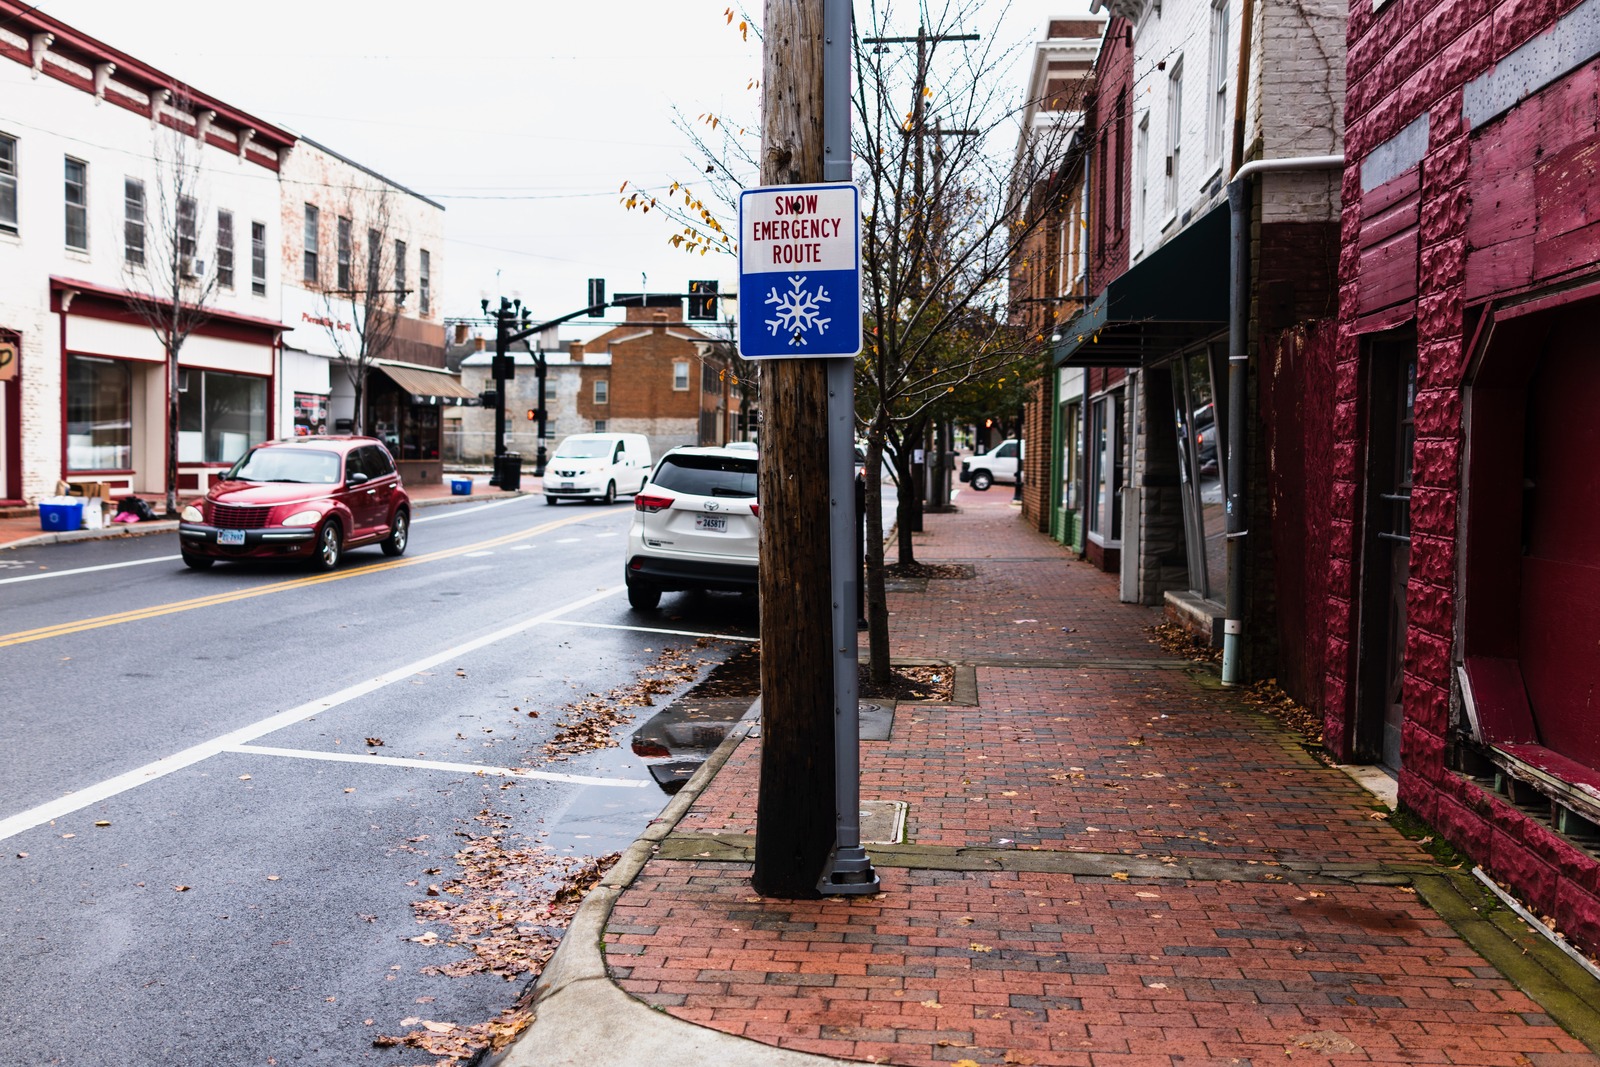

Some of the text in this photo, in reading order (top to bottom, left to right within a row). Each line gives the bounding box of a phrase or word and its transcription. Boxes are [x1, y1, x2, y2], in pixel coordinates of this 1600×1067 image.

[775, 195, 818, 215] SNOW
[753, 218, 841, 241] EMERGENCY
[773, 243, 821, 264] ROUTE
